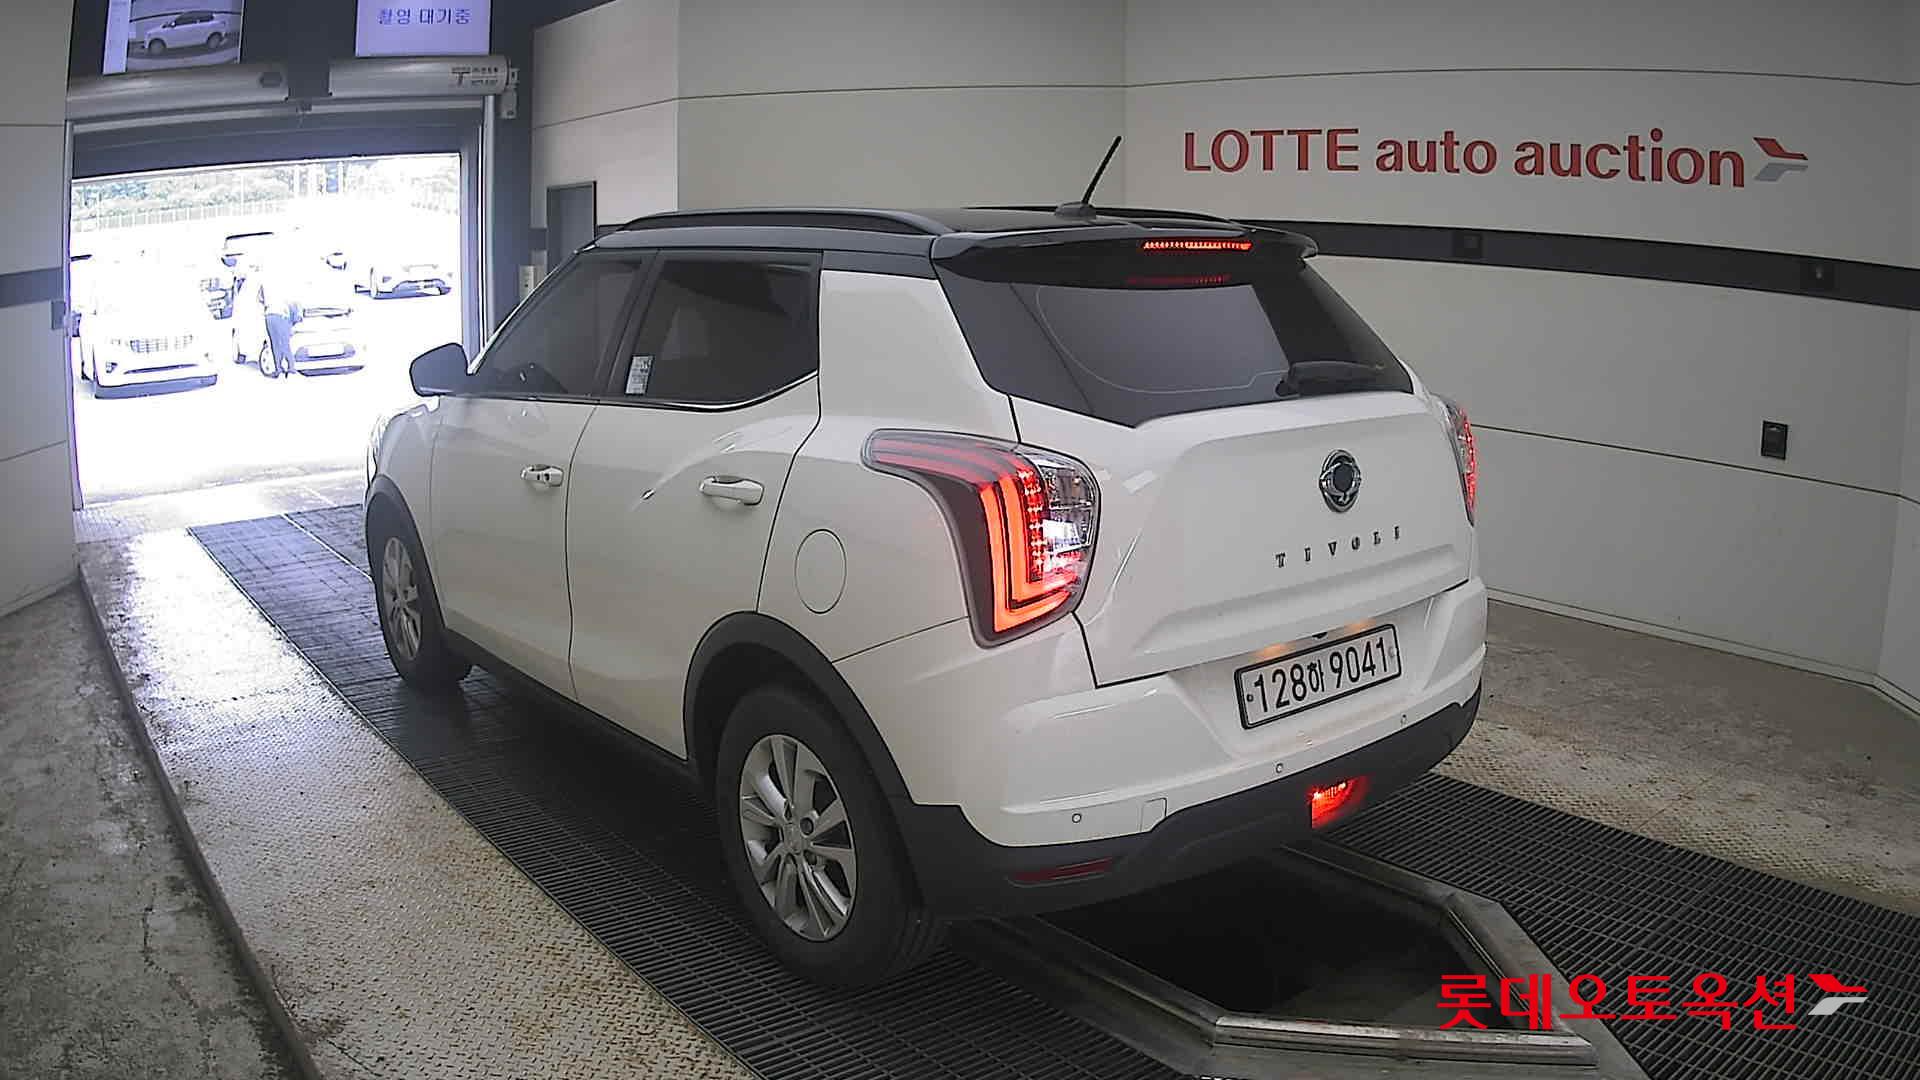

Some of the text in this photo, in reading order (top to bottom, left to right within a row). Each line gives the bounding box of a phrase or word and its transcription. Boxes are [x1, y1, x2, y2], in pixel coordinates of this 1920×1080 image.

[419, 7, 471, 25] 대기중
[1184, 128, 1745, 188] LOTTE auto auction
[1275, 526, 1401, 569] TIVOLI
[1254, 636, 1390, 713] 128하 9041
